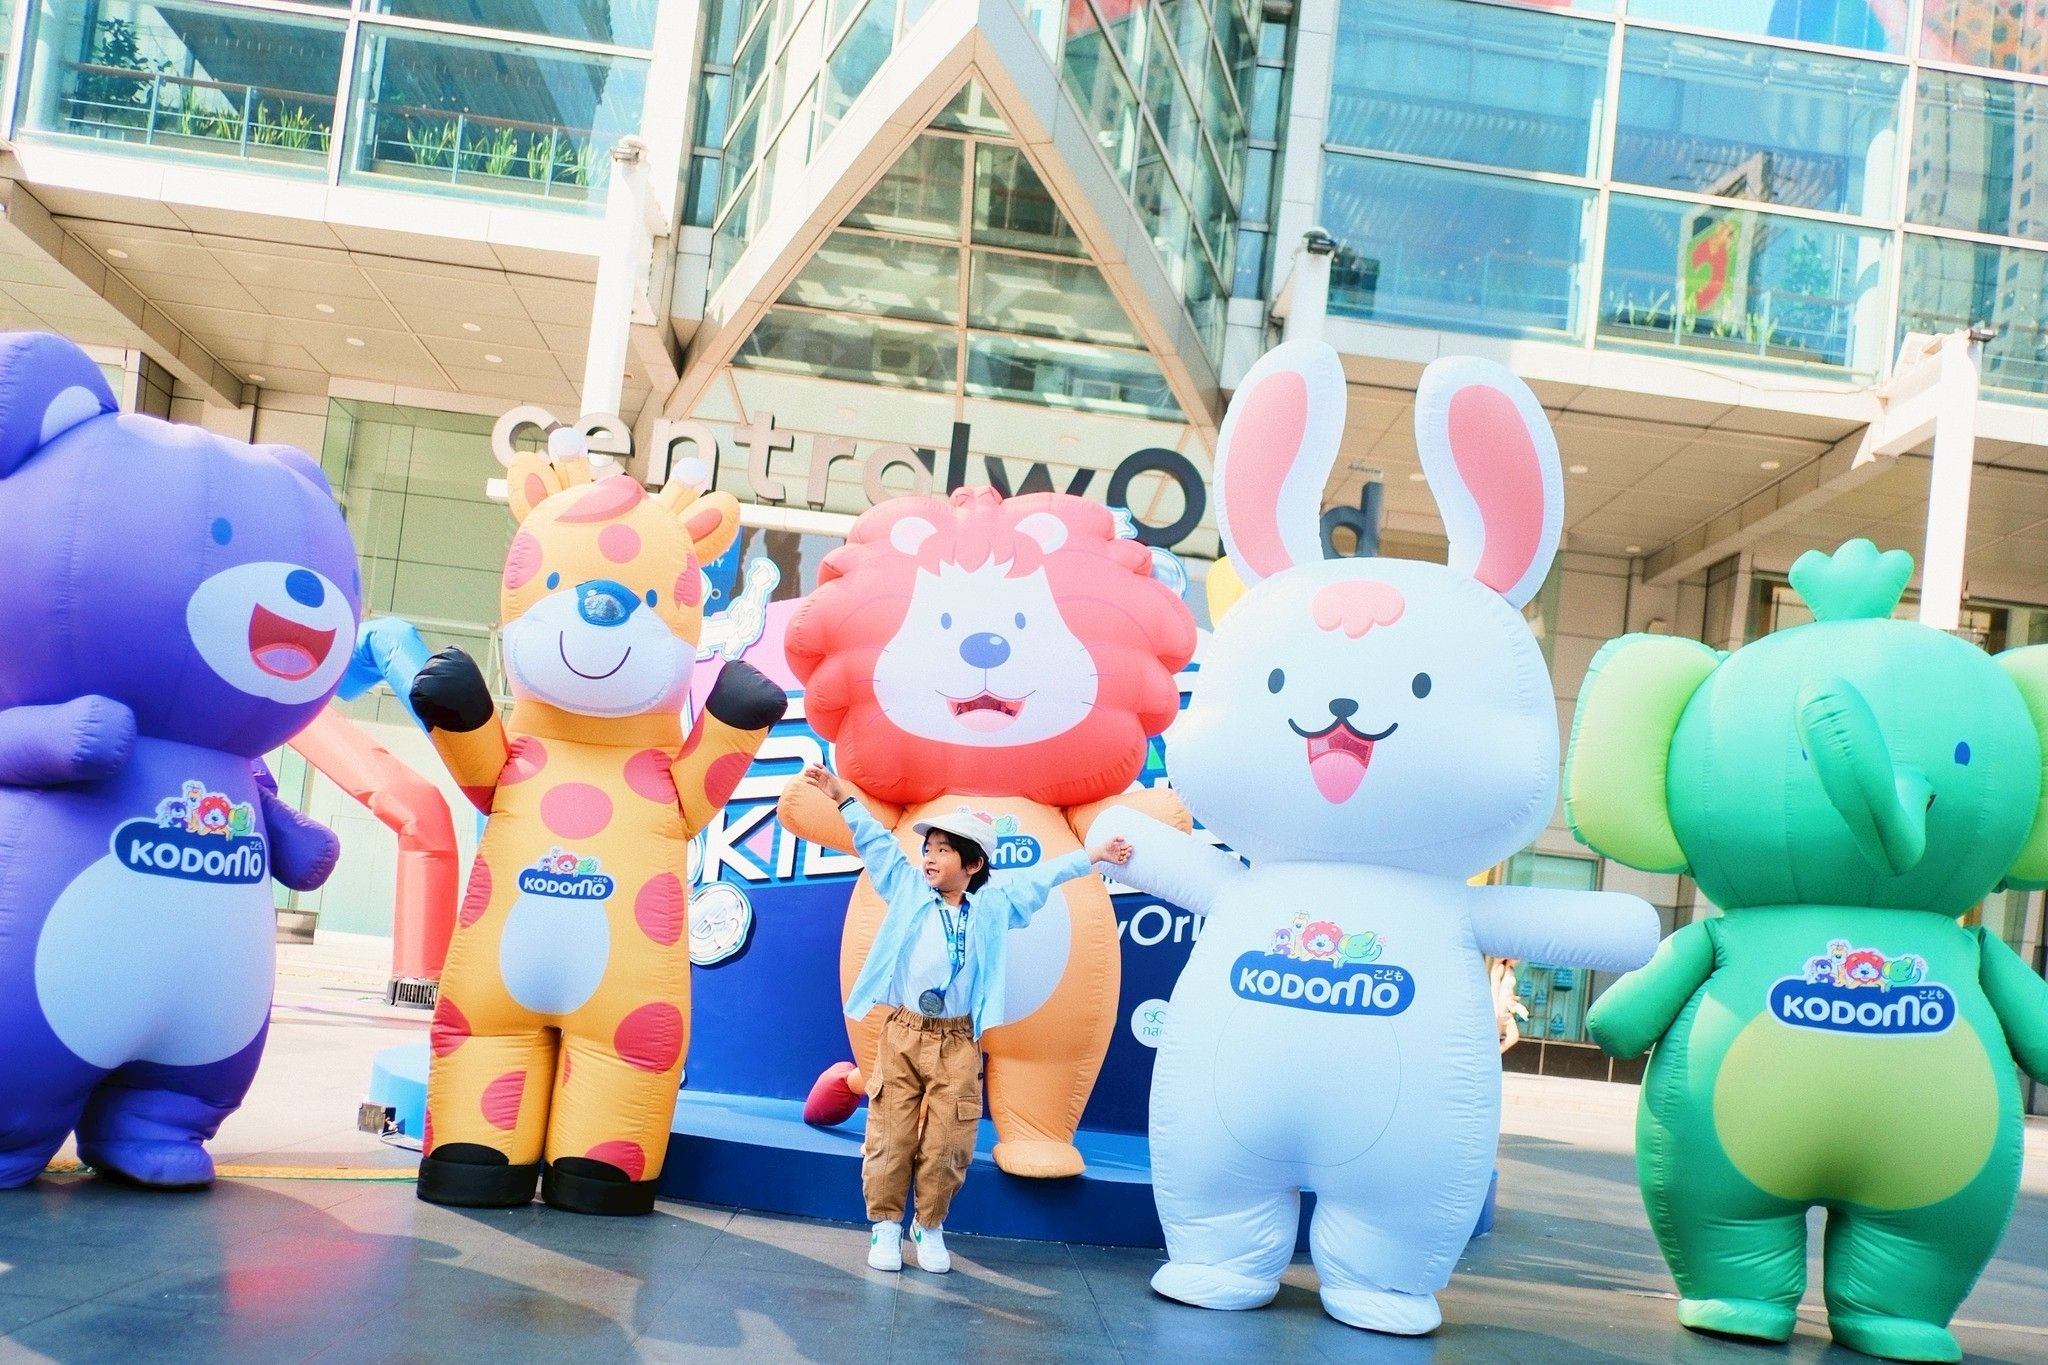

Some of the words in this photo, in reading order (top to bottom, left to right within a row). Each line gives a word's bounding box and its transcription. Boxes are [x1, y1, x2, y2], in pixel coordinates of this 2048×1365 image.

[1373, 969, 1404, 982] こども
[1919, 989, 1945, 1000] こども
